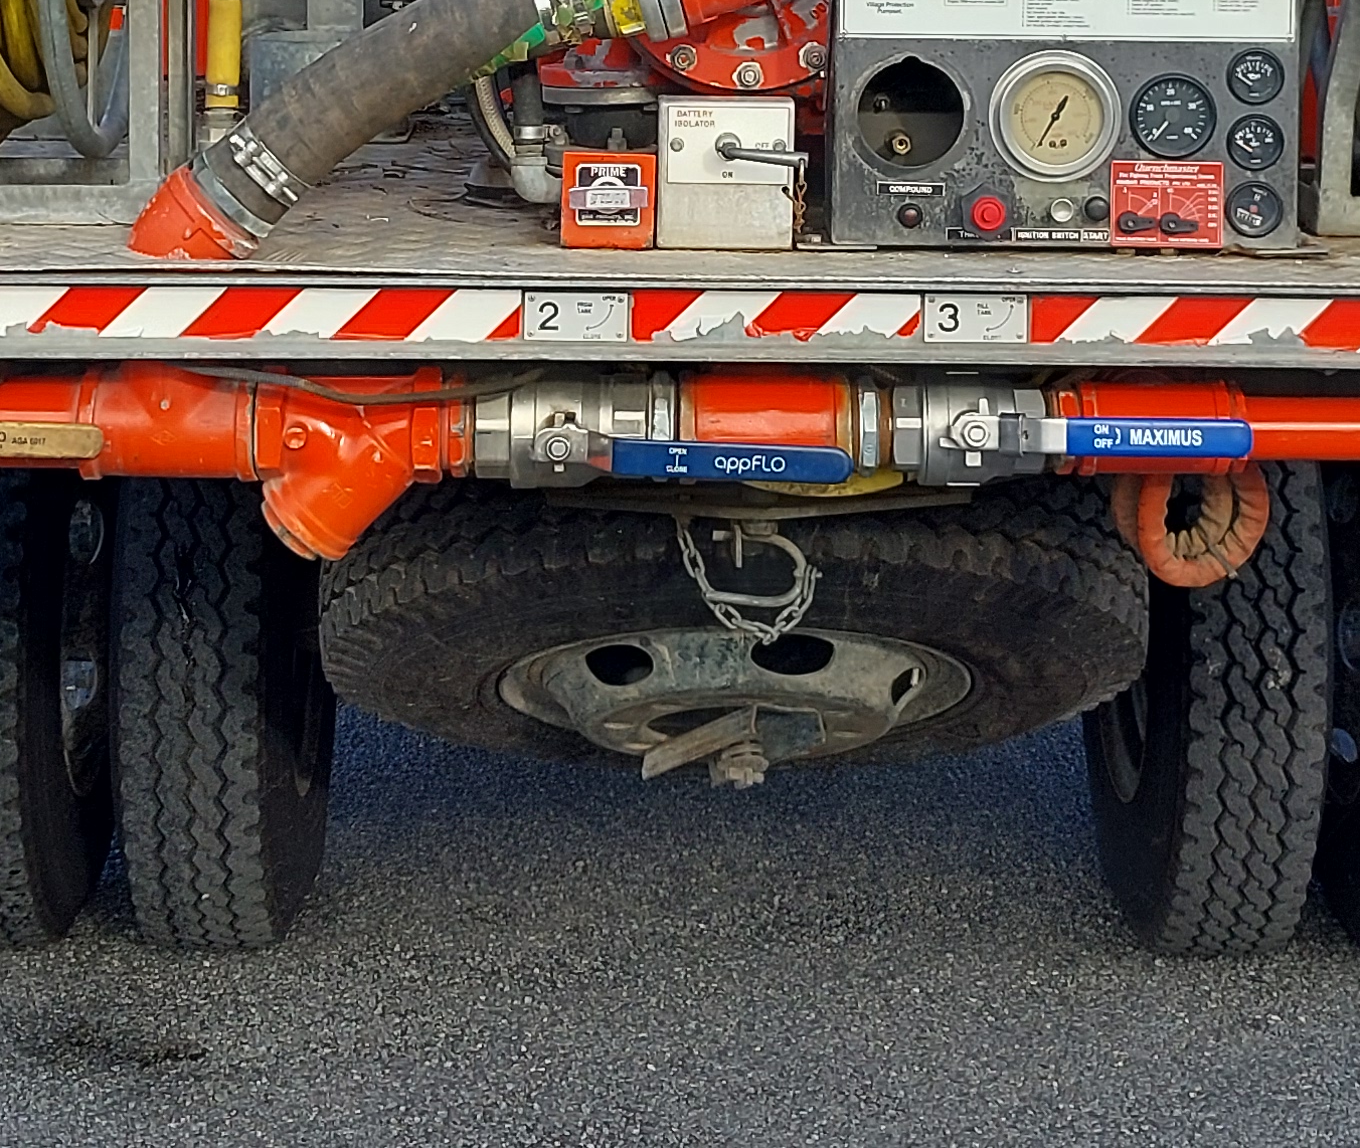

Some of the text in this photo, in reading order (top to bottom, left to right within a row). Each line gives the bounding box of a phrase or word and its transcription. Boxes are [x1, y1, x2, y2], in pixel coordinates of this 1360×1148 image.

[866, 1, 885, 9] Village
[676, 109, 714, 118] BATTERY
[674, 119, 716, 128] ISOLATOR
[754, 142, 770, 151] OFF
[590, 166, 628, 178] PRIME
[721, 171, 734, 179] ON
[889, 185, 933, 193] COMPOUND
[1082, 231, 1109, 240] START
[537, 301, 559, 331] 2
[938, 303, 959, 332] 3
[1093, 424, 1110, 435] ON
[1129, 428, 1203, 447] MAXIMUS
[1093, 438, 1114, 449] OFF
[668, 447, 688, 455] OPEN
[714, 454, 786, 474] appFLO
[665, 465, 688, 473] CLOSE
